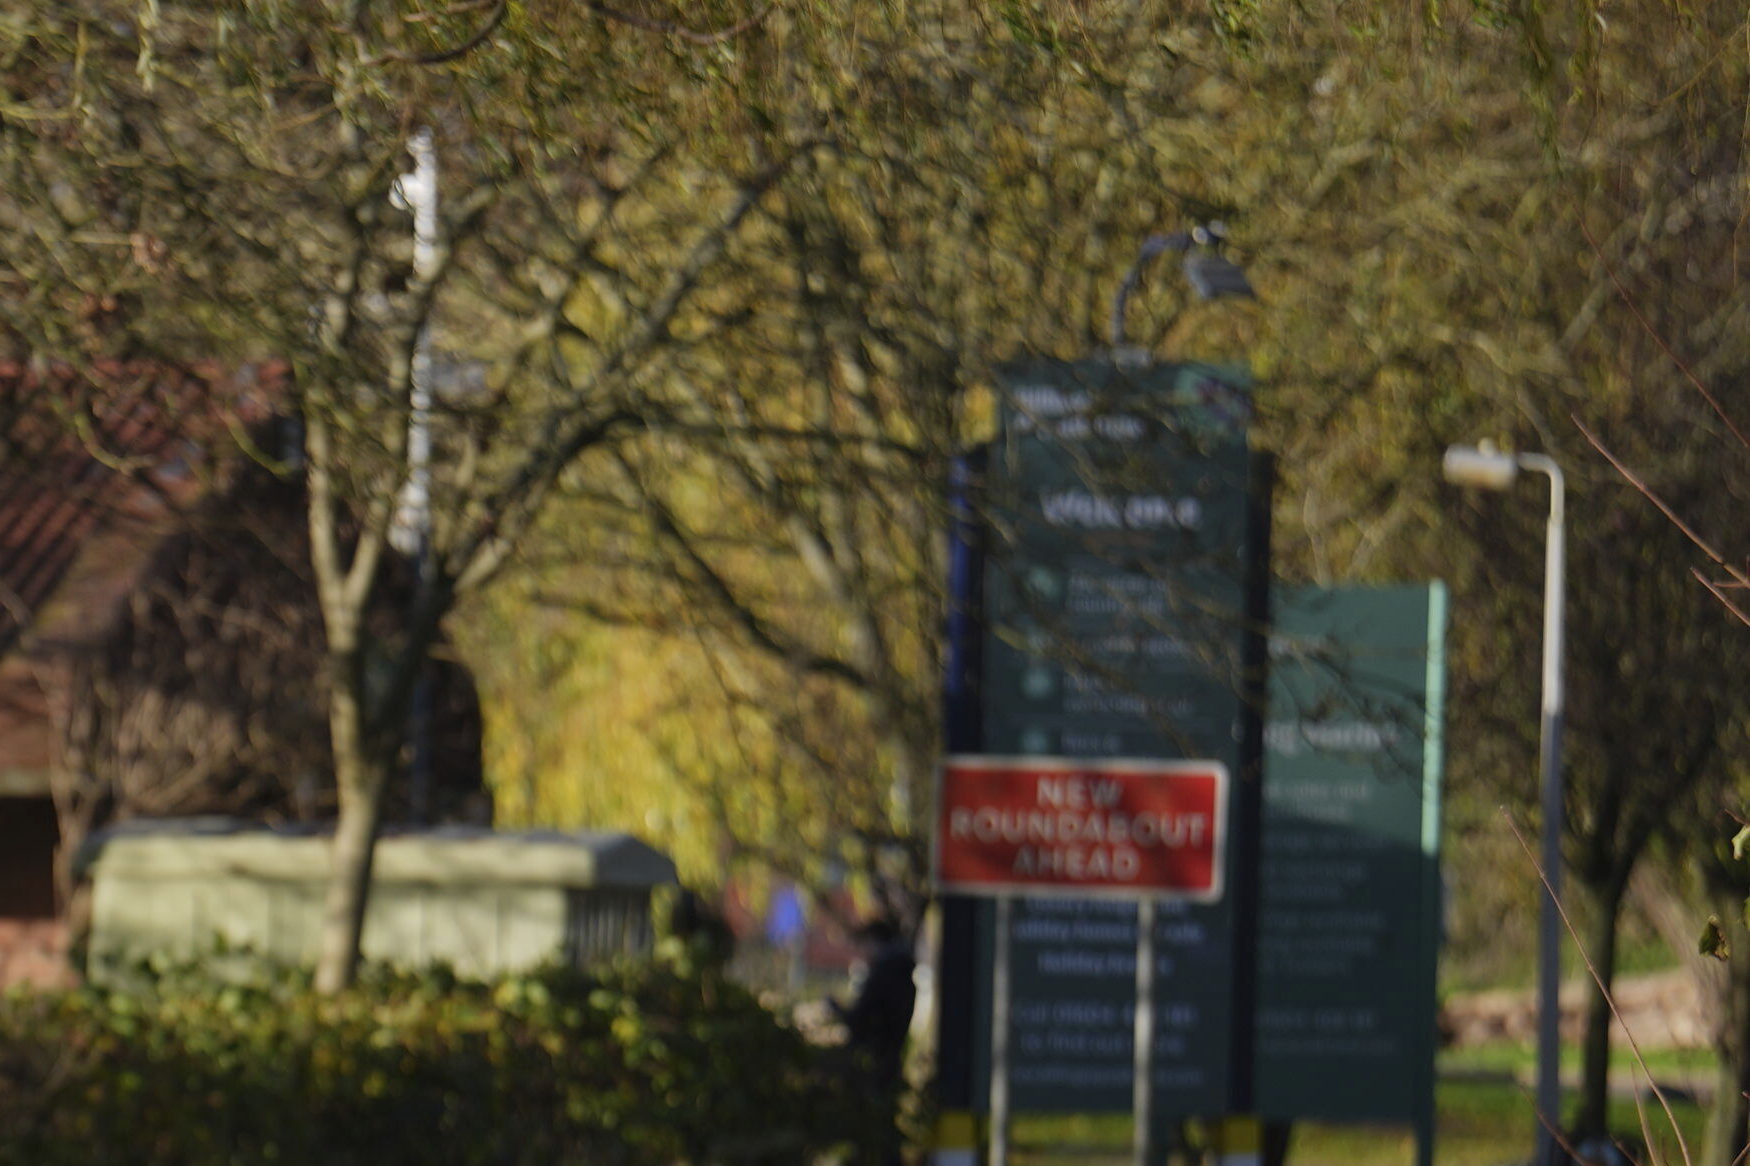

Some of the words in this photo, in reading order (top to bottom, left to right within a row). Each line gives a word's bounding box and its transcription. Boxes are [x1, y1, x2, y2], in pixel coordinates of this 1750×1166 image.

[1036, 775, 1122, 807] NEW
[950, 805, 1209, 848] ROUNDABOUT
[1012, 845, 1140, 881] AHEAD
